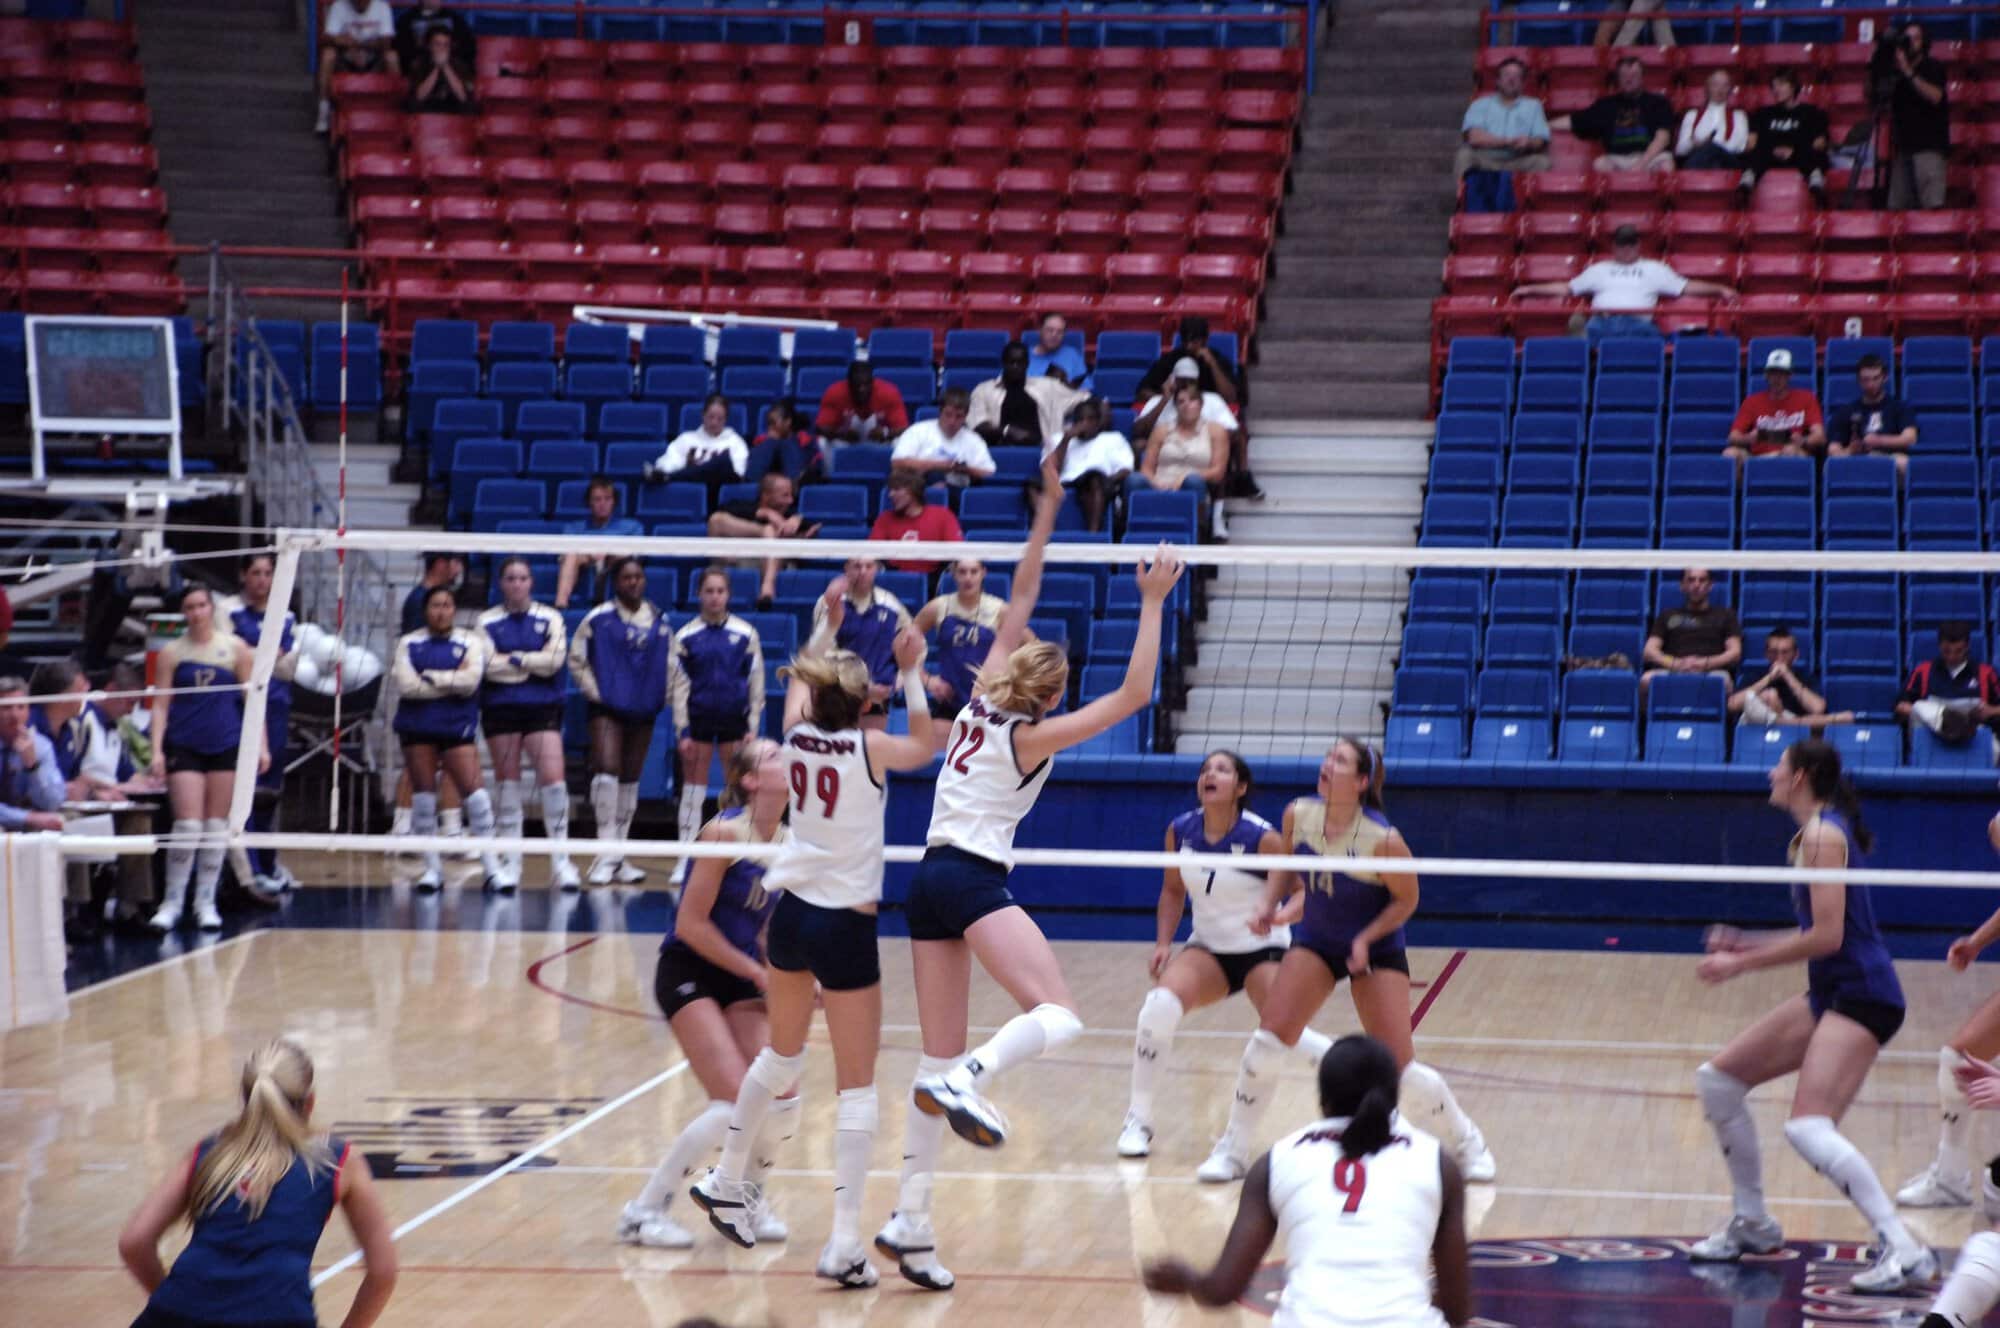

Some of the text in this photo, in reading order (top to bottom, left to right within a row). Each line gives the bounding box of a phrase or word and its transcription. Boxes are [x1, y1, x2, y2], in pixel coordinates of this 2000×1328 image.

[952, 624, 979, 648] 24
[946, 719, 985, 776] 12
[791, 761, 839, 818] 99
[1201, 866, 1217, 896] 7
[1333, 1156, 1367, 1213] 9
